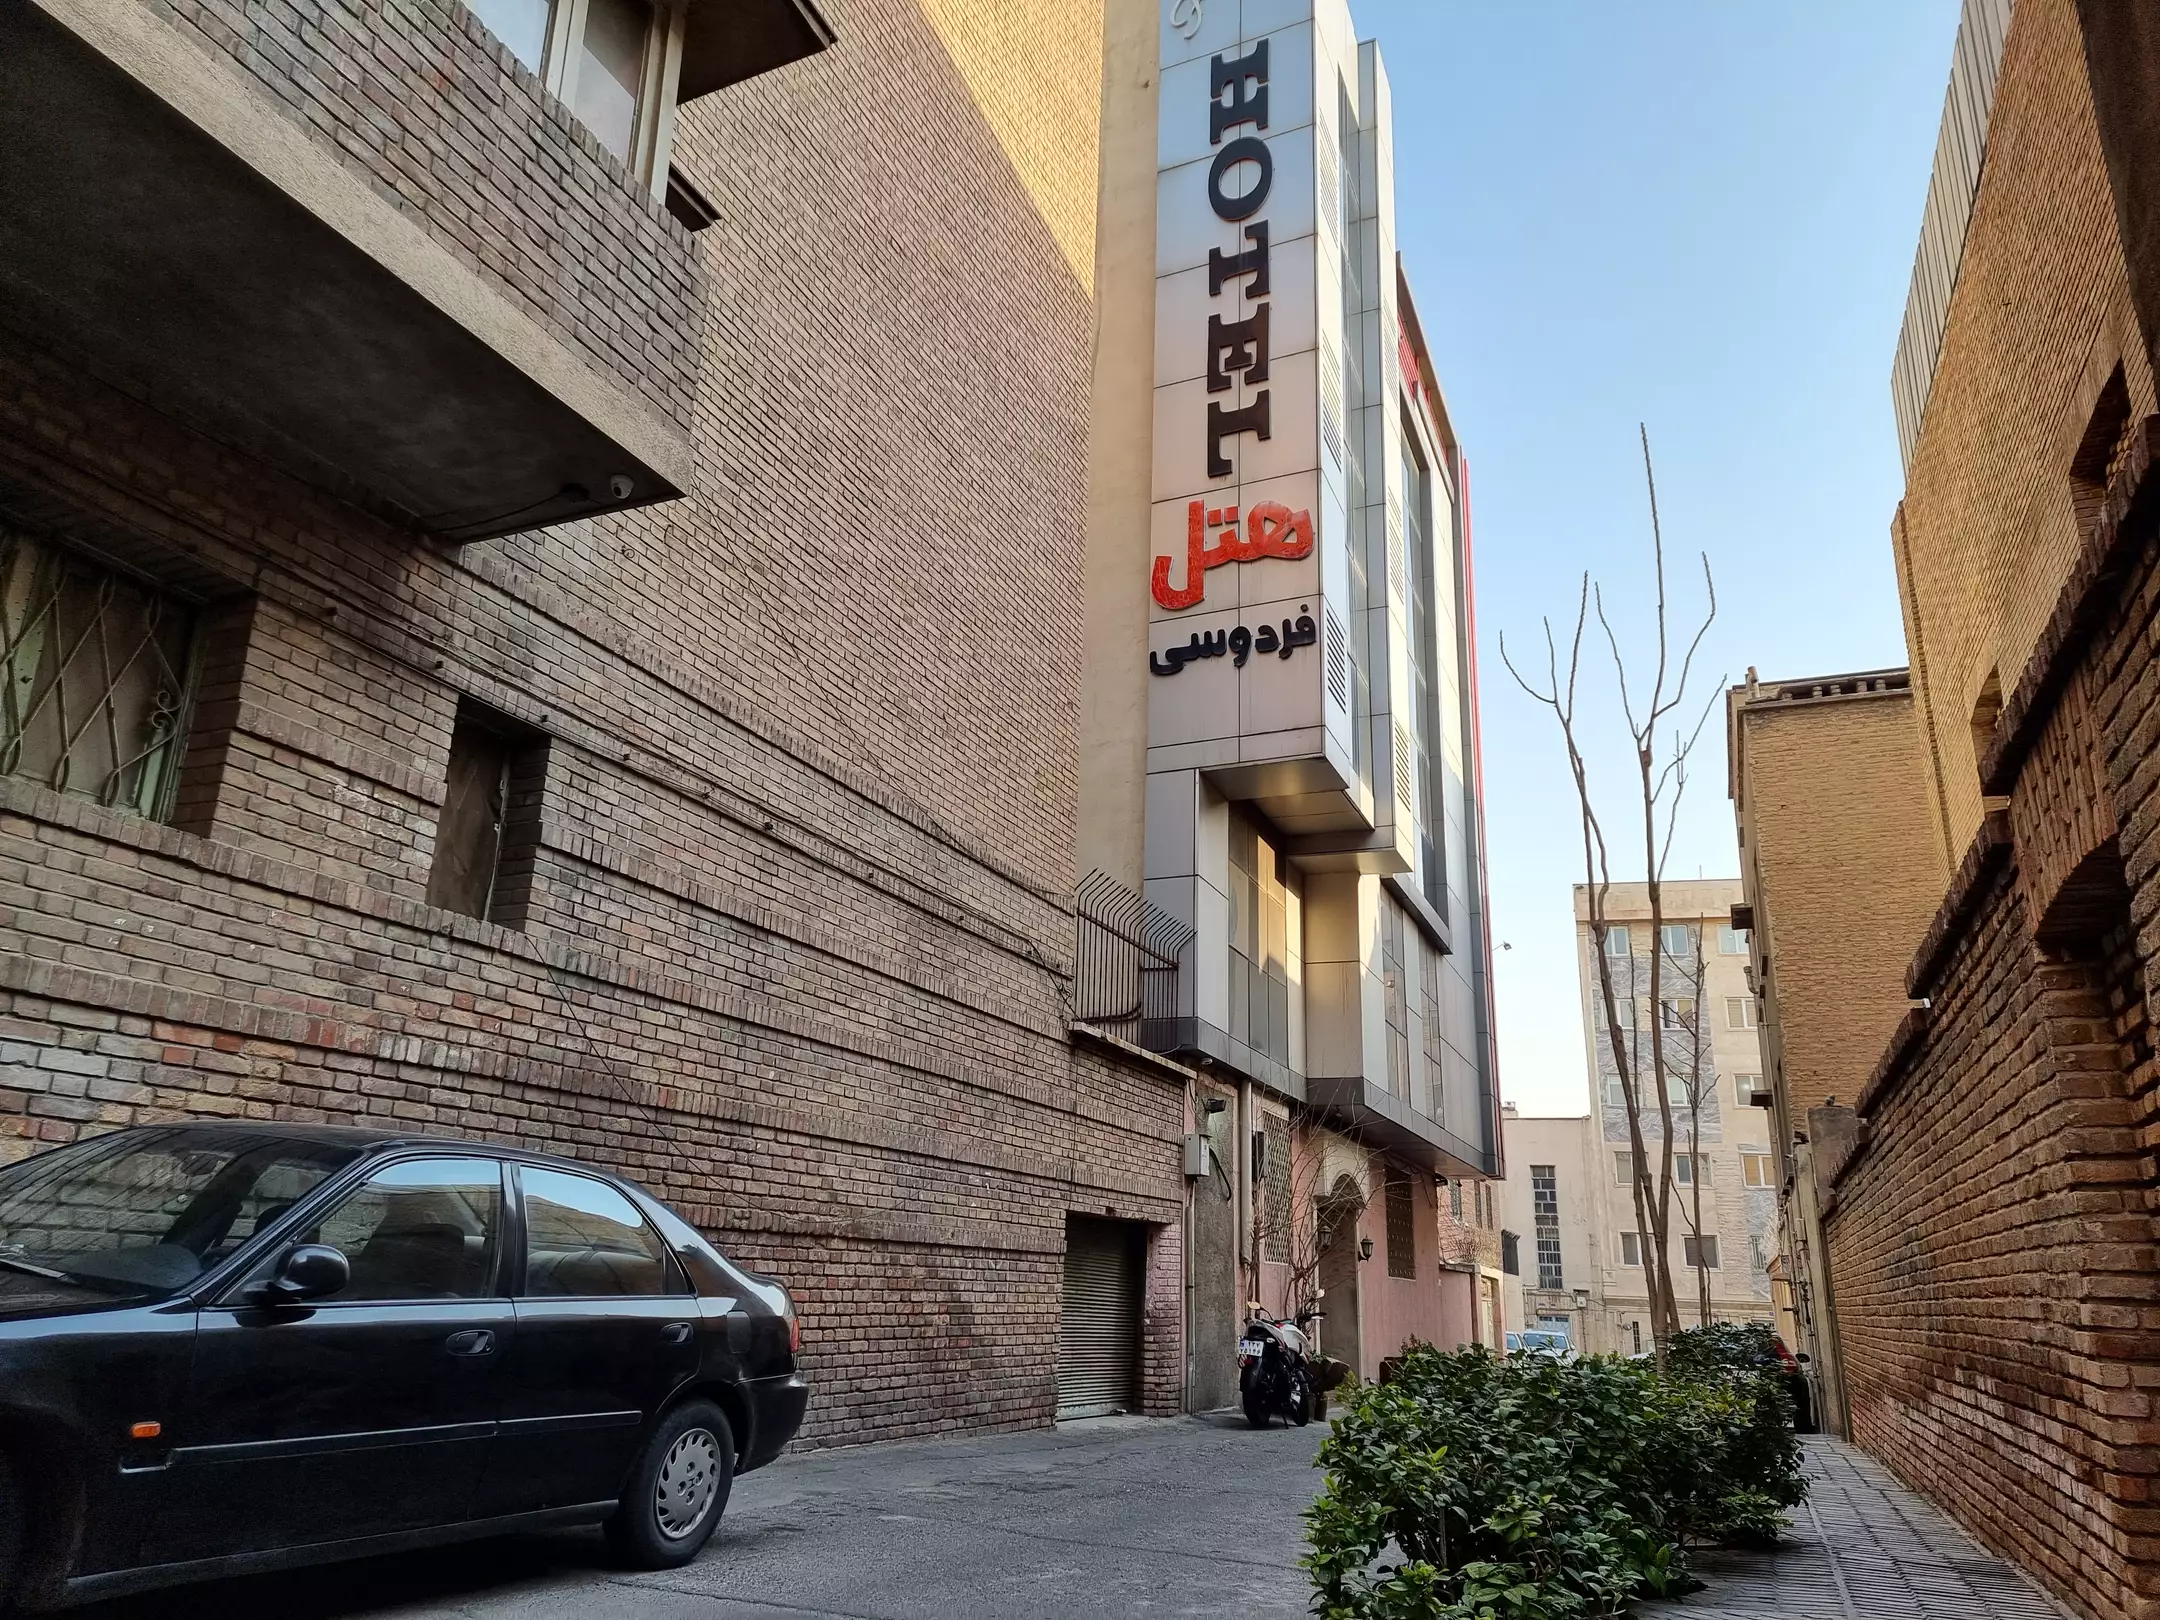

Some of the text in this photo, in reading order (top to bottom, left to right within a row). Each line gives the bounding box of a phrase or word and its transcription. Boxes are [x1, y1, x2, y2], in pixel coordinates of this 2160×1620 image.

[1207, 38, 1273, 478] HOTEL
[1151, 499, 1315, 611] هتل
[1149, 604, 1317, 676] فردوسی
